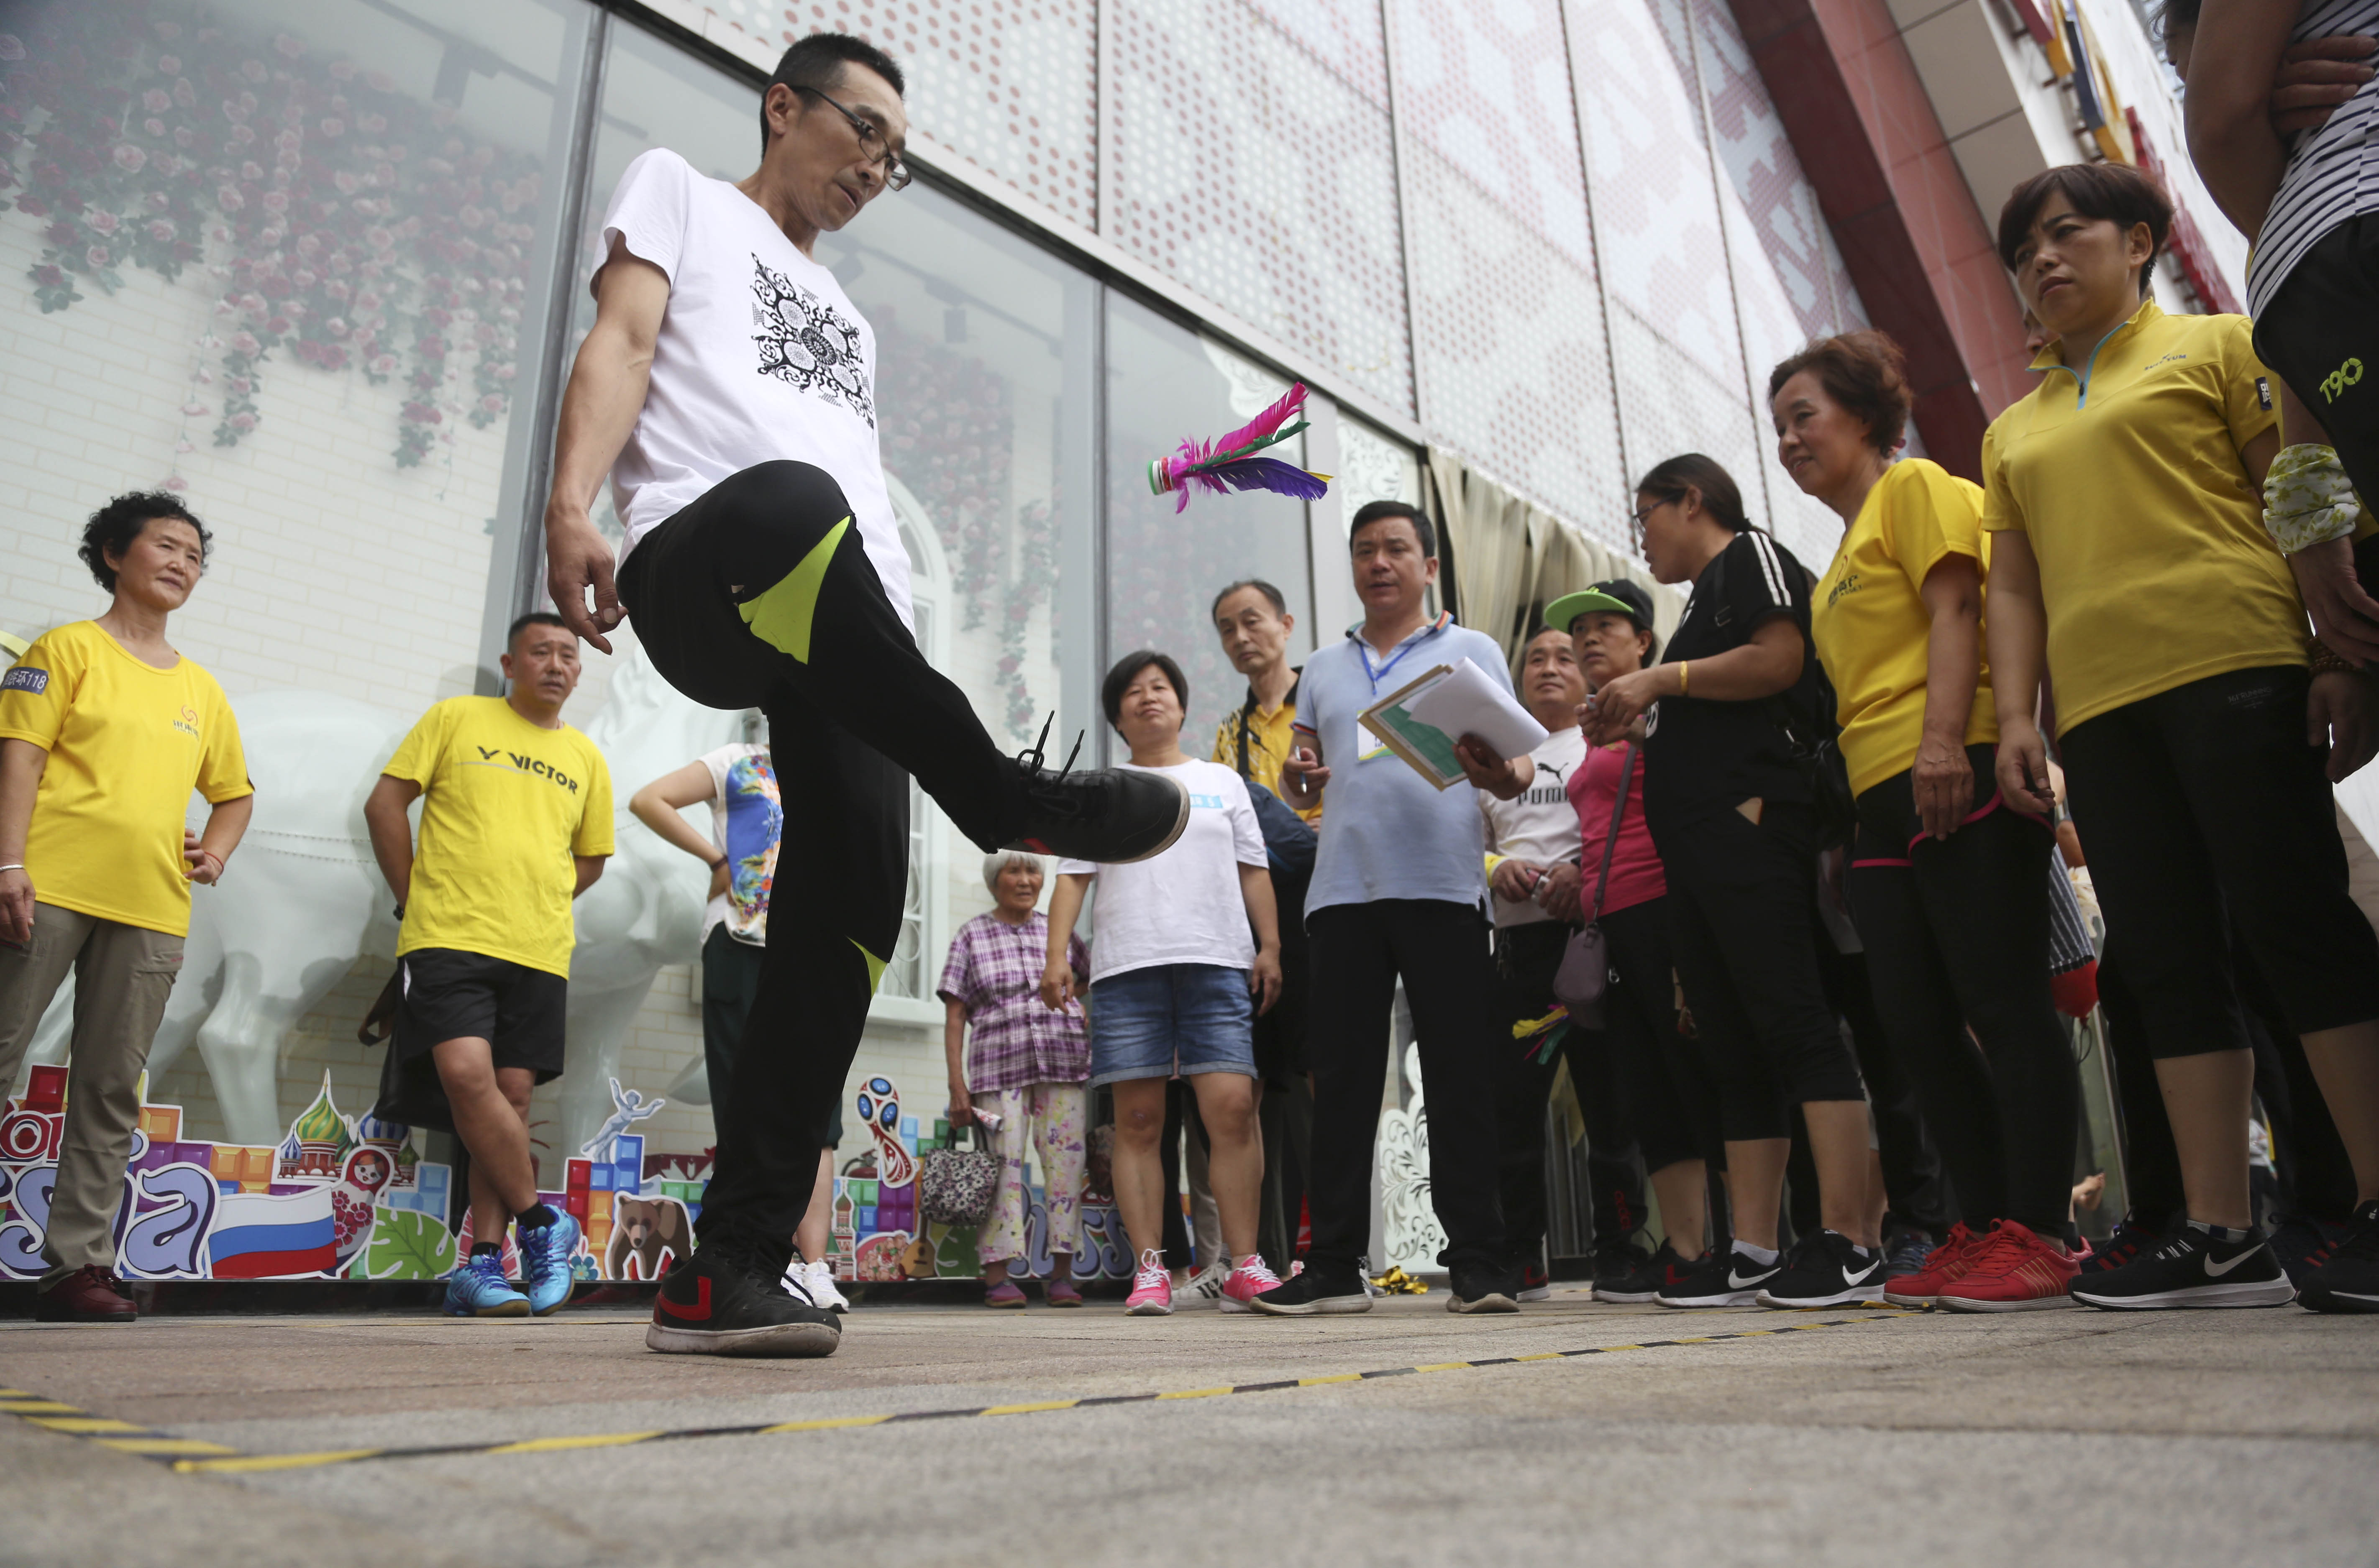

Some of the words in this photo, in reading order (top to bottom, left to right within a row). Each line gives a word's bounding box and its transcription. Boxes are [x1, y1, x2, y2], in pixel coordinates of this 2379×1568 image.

[2320, 358, 2363, 404] T90
[507, 752, 578, 795] VICTOR
[1517, 785, 1570, 807] PUM
